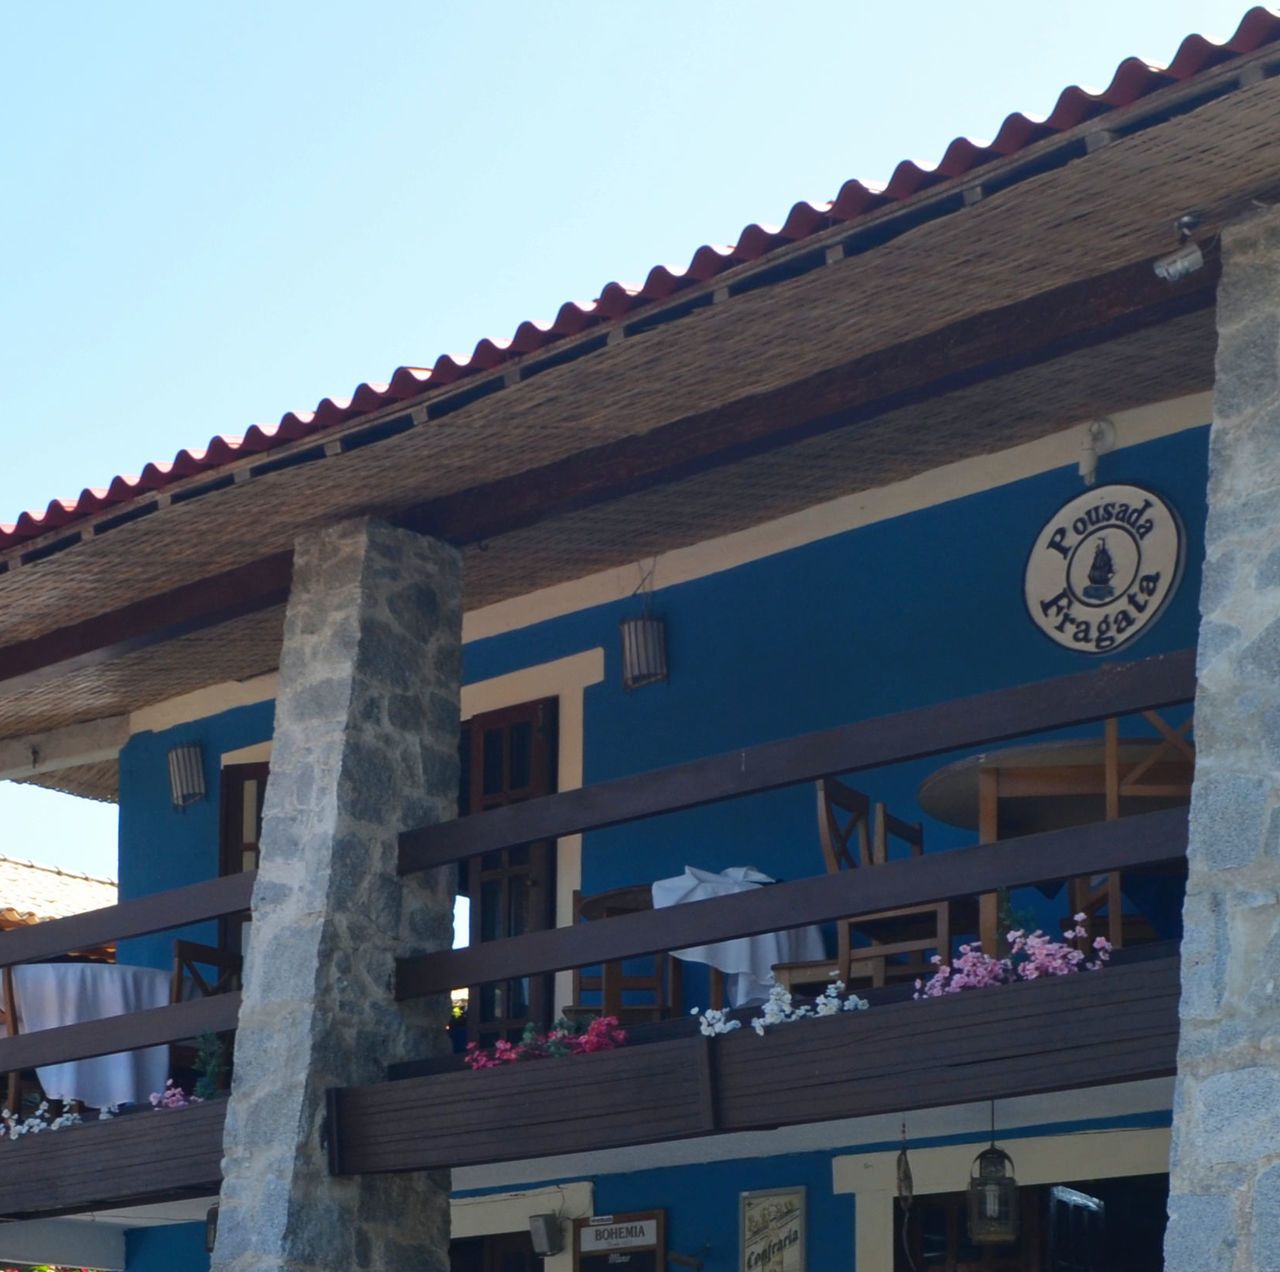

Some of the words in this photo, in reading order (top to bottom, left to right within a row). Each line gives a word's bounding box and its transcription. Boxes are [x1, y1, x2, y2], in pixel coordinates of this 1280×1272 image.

[1047, 499, 1154, 560] Pousada
[1040, 572, 1161, 649] Fragata
[594, 1225, 645, 1241] BOHEMIA
